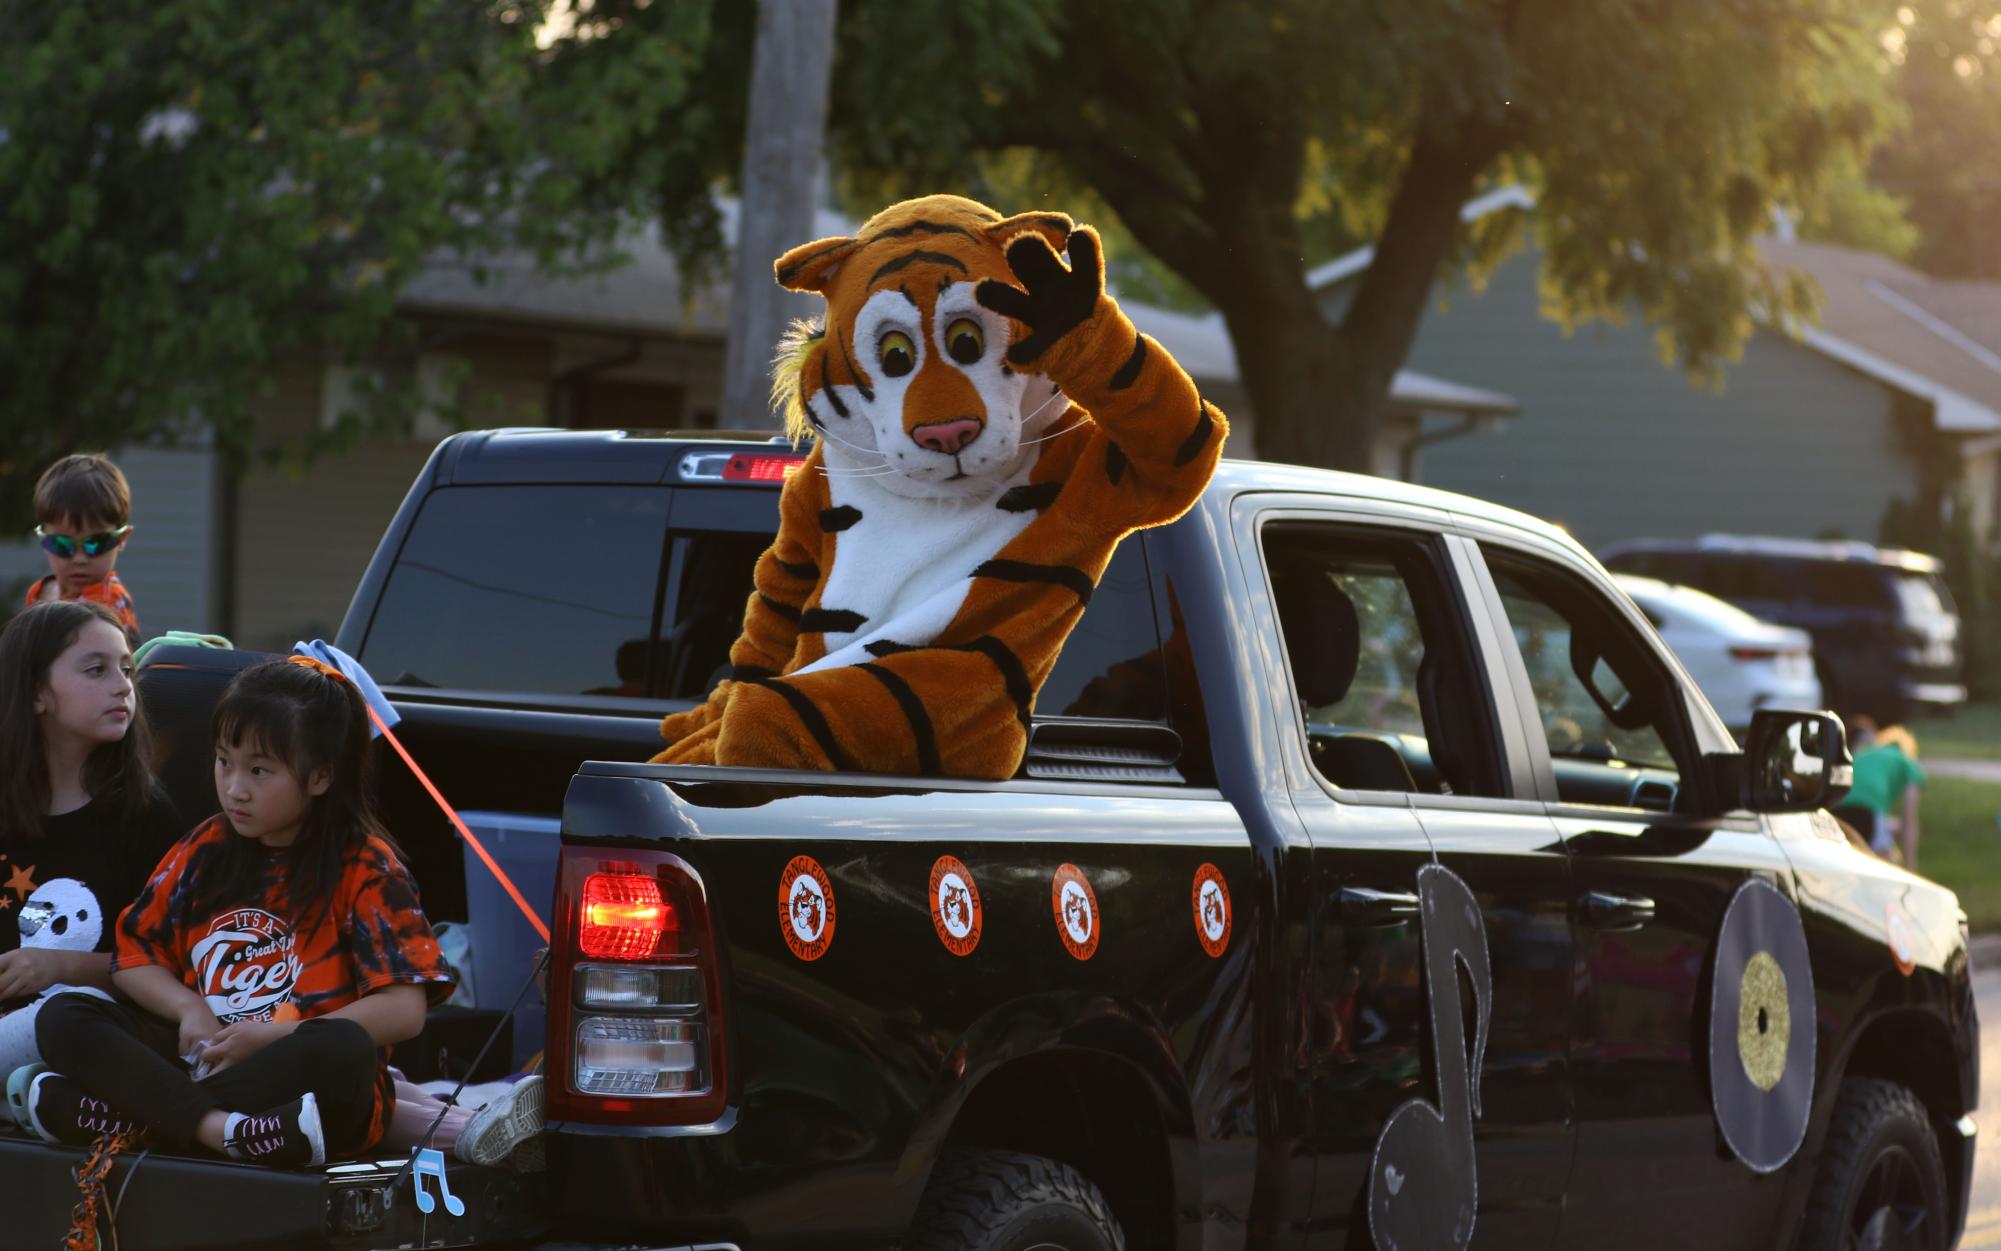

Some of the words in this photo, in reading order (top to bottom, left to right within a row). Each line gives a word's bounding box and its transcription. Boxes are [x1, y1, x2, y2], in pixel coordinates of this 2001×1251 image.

[782, 857, 834, 923] TANGLEWOOD
[930, 858, 980, 909] TANGLEWOOD
[234, 912, 261, 929] IT'S
[262, 918, 274, 934] A
[780, 902, 827, 959] ELEMENTARY
[933, 911, 979, 955] ELEMENTARY
[191, 930, 303, 1009] Tiger
[245, 940, 277, 961] Great
